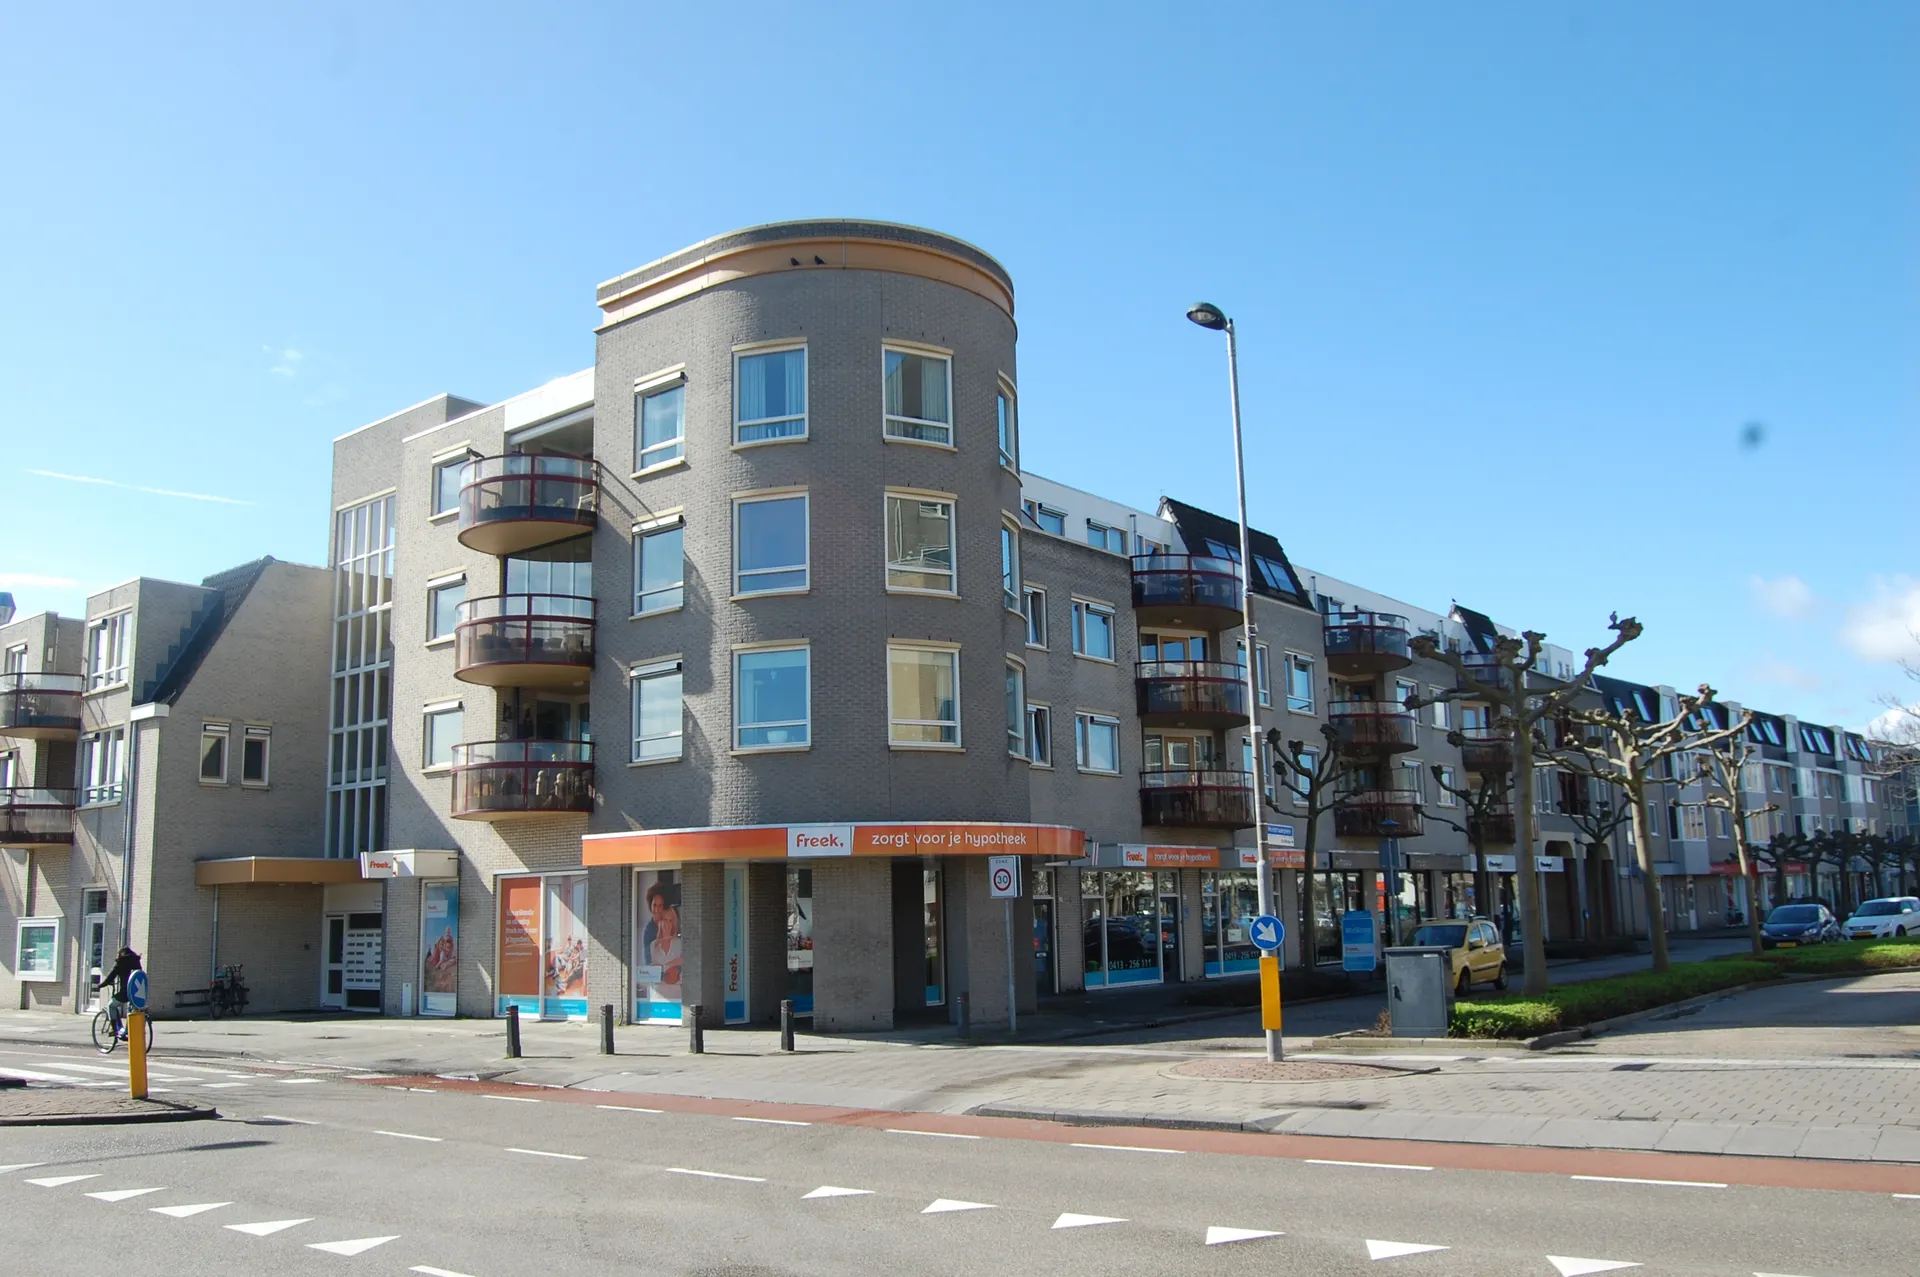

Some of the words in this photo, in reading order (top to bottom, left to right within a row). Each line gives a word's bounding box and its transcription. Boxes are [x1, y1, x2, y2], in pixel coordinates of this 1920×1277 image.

[871, 832, 910, 848] zorgt
[914, 833, 946, 845] voor
[948, 832, 961, 847] je
[965, 832, 1027, 847] hypotheek
[997, 875, 1008, 885] 30
[1109, 960, 1124, 970] 0413
[1128, 959, 1140, 969] 256
